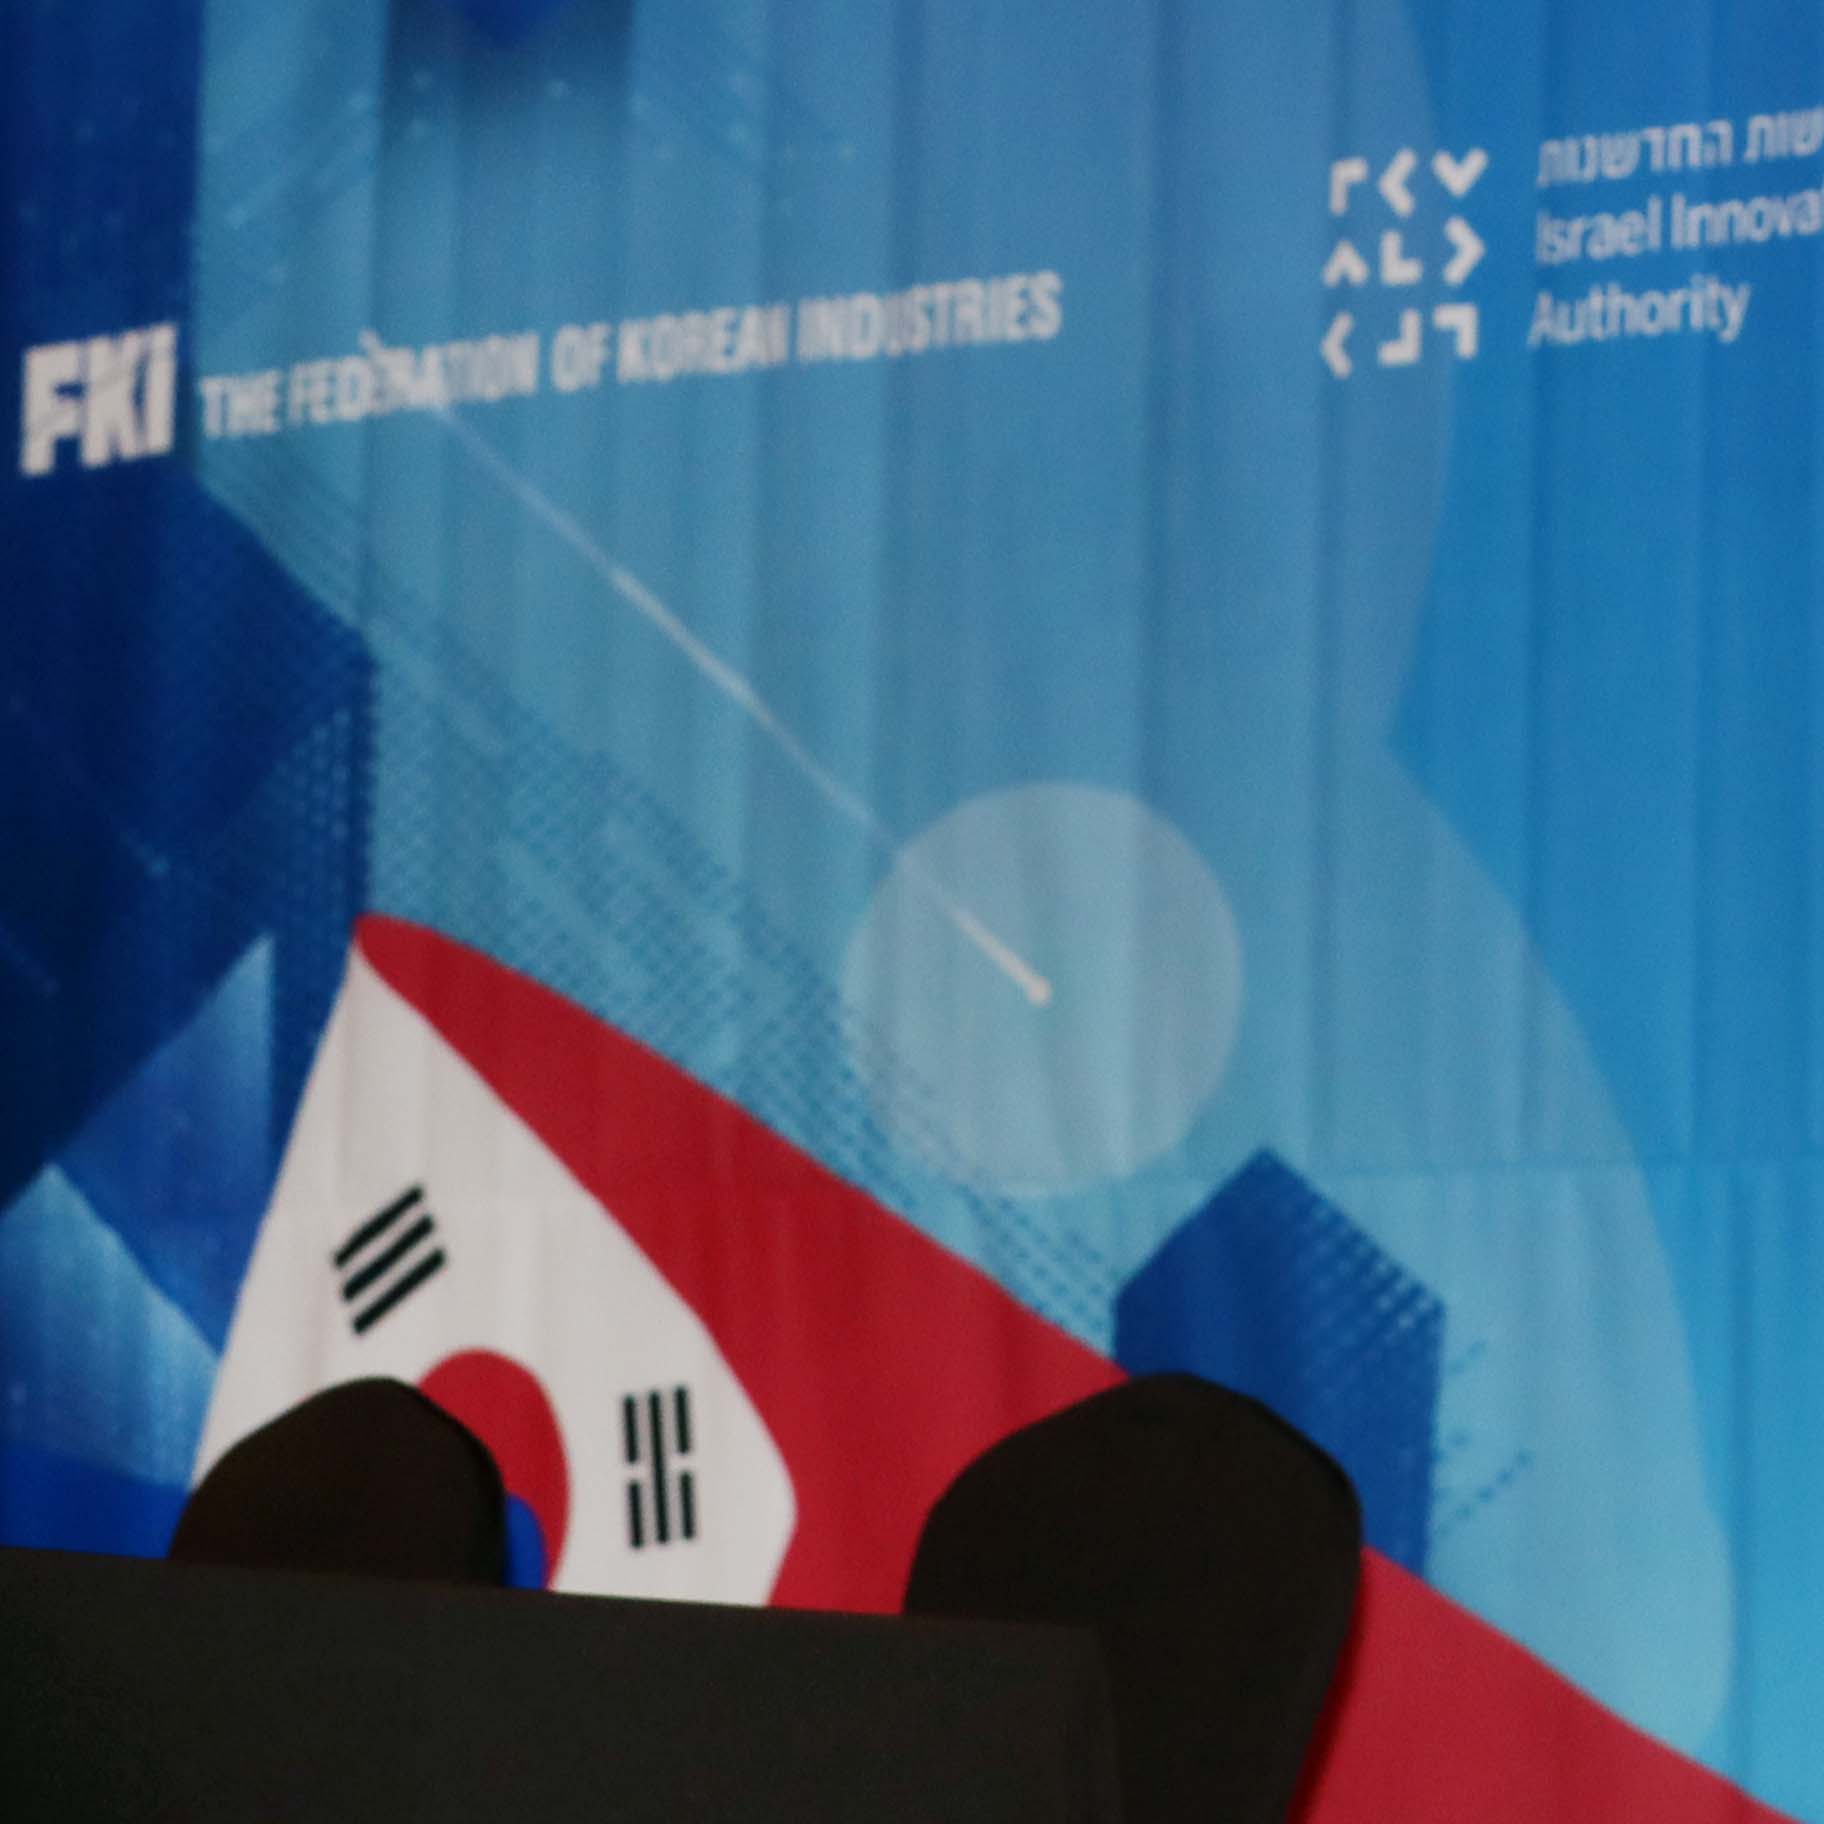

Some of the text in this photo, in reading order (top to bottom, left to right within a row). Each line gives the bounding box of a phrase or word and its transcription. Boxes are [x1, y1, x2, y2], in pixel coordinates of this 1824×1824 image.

[1536, 193, 1663, 265] Israel
[1527, 273, 1751, 347] Authority
[21, 322, 178, 476] FKI
[203, 371, 281, 439] THE
[551, 322, 613, 394] OF
